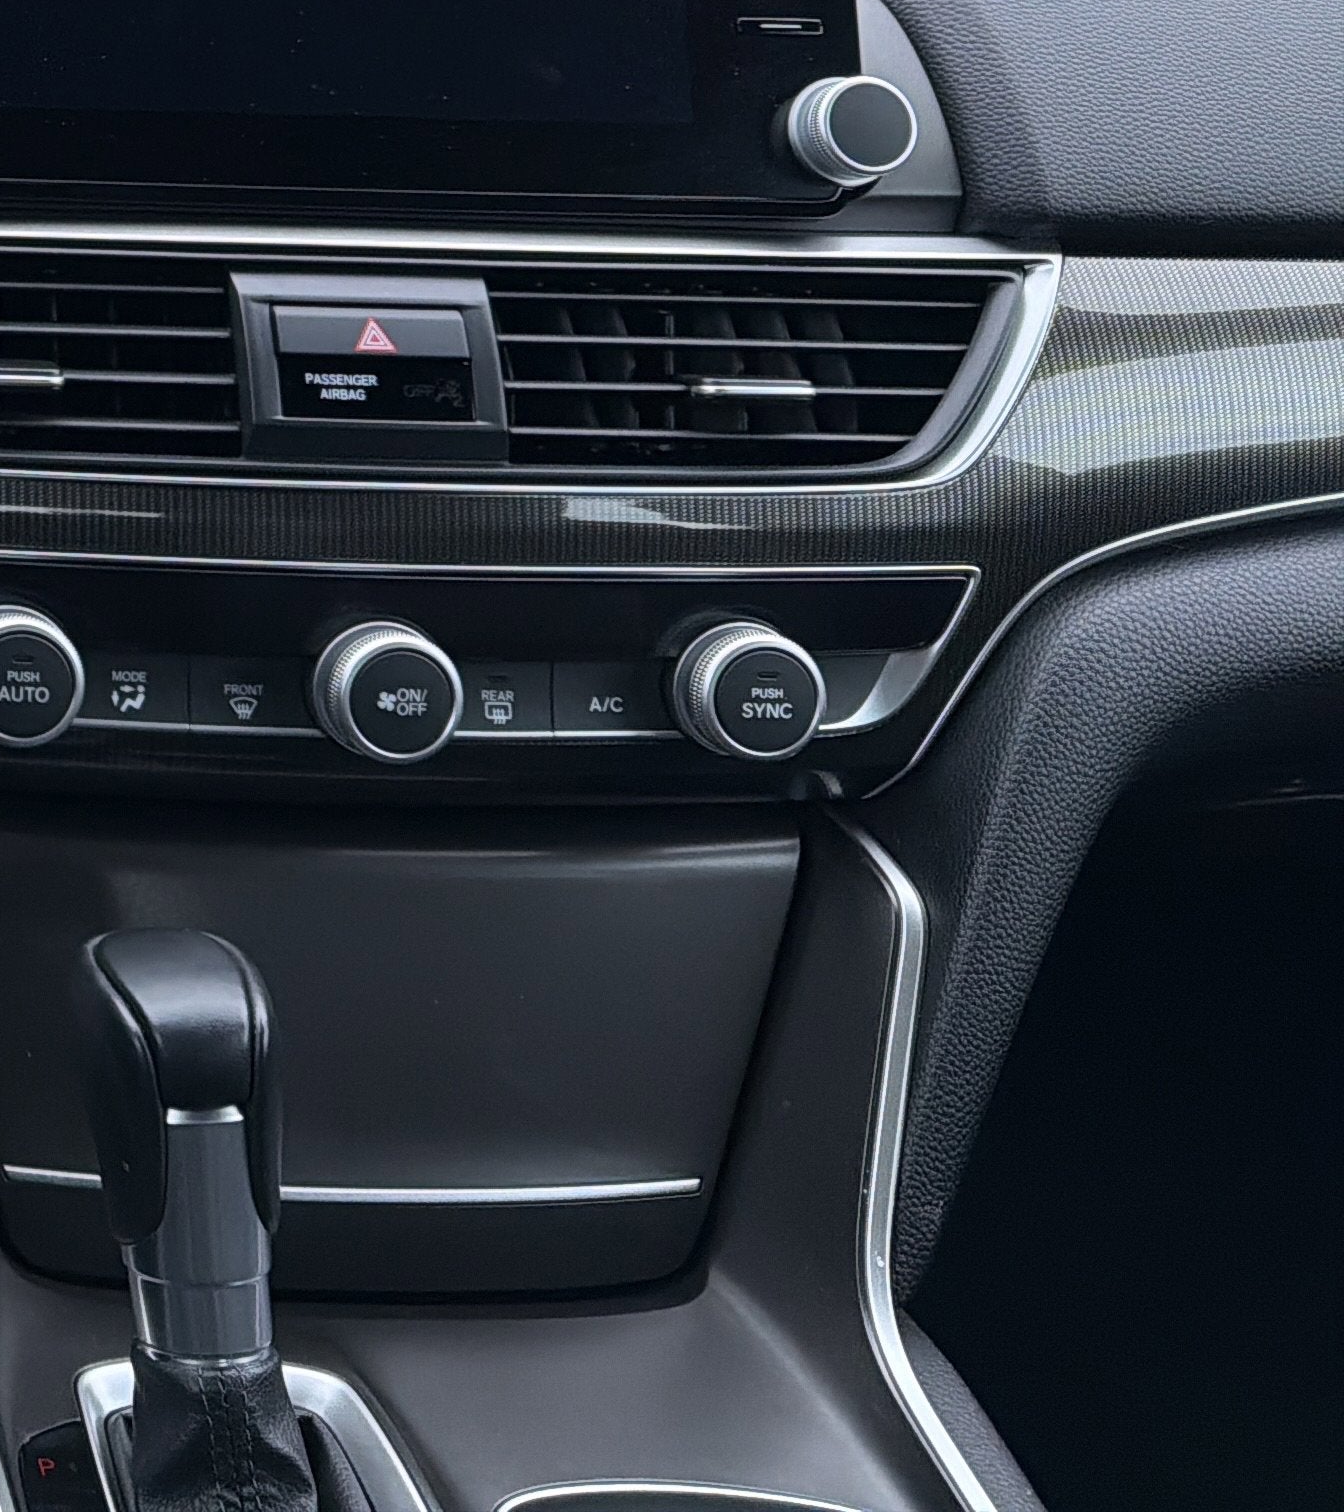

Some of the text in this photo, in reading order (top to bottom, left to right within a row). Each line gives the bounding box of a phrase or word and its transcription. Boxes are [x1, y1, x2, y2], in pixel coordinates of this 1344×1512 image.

[304, 372, 379, 387] PASSENGER
[320, 388, 367, 402] AIRBAG
[6, 670, 41, 684] PUSH
[111, 670, 147, 683] MODE
[223, 683, 264, 697] FRONT
[480, 689, 515, 703] REAR
[751, 687, 785, 700] PUSH
[396, 702, 428, 716] OFF
[589, 695, 624, 713] A/C
[741, 702, 794, 720] SYNC
[37, 1457, 56, 1477] P
